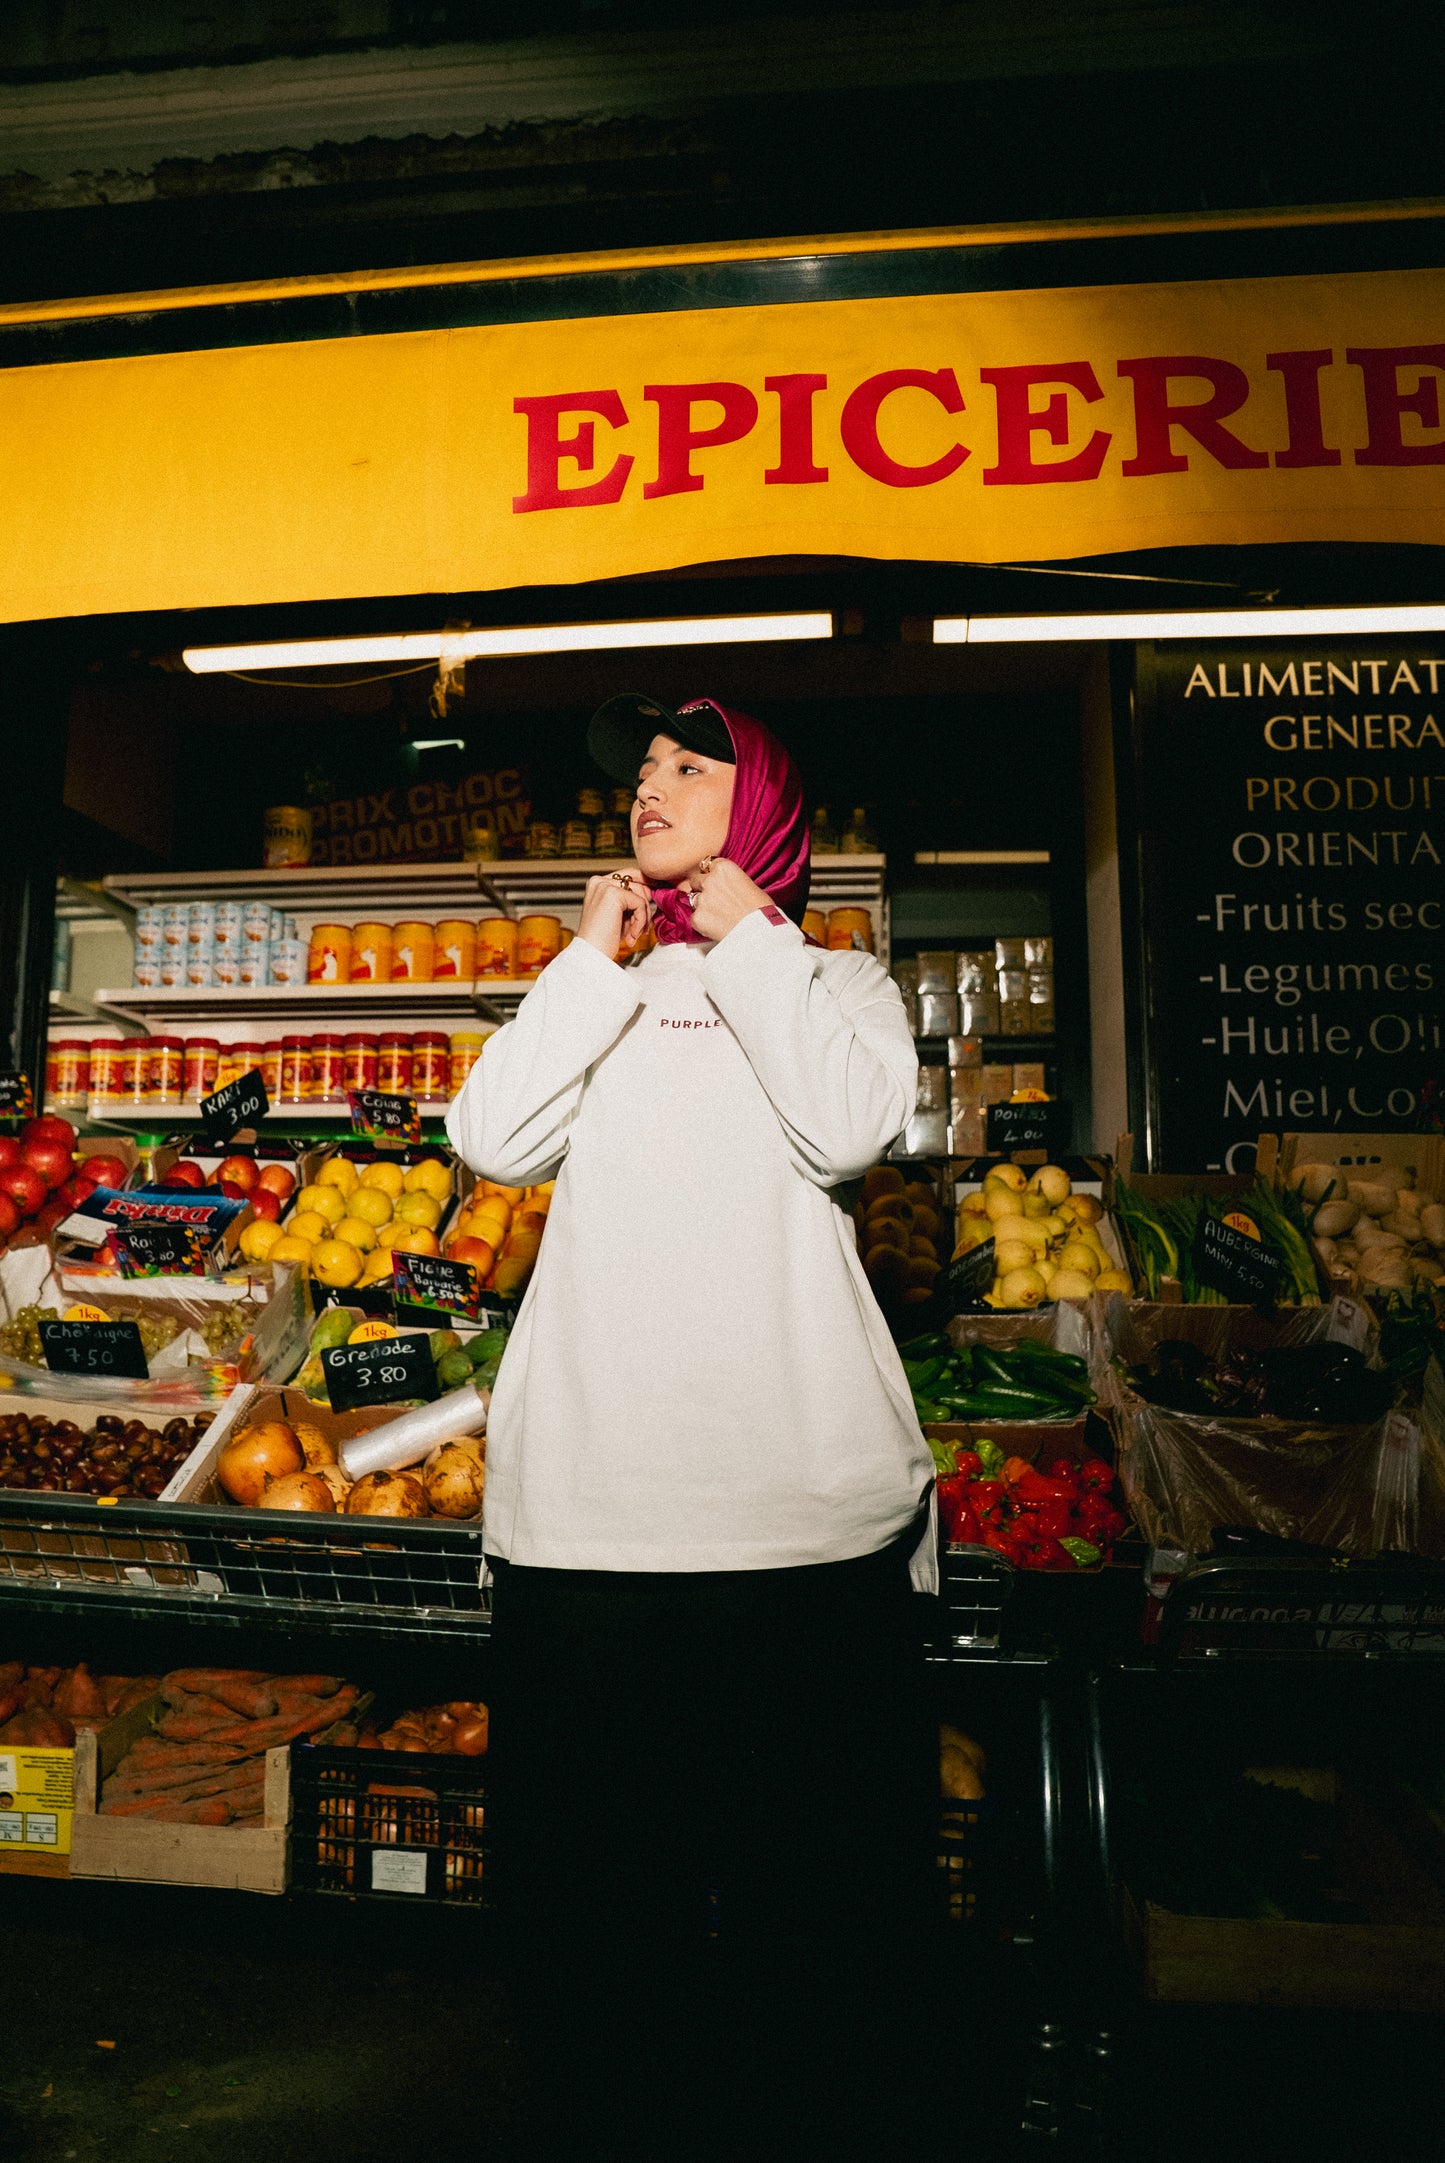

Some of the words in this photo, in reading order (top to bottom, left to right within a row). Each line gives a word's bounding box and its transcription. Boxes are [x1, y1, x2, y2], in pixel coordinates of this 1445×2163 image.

[512, 343, 1445, 514] EPICERIE
[1183, 659, 1445, 699] ALIMENTAT
[1263, 713, 1445, 751] GENERA
[311, 787, 399, 828] PRIX
[407, 768, 523, 817] CHOC
[1231, 1215, 1251, 1233] 1kg
[78, 1308, 100, 1322] 1kg
[364, 1325, 387, 1340] 1kg
[357, 1366, 407, 1388] 3.80
